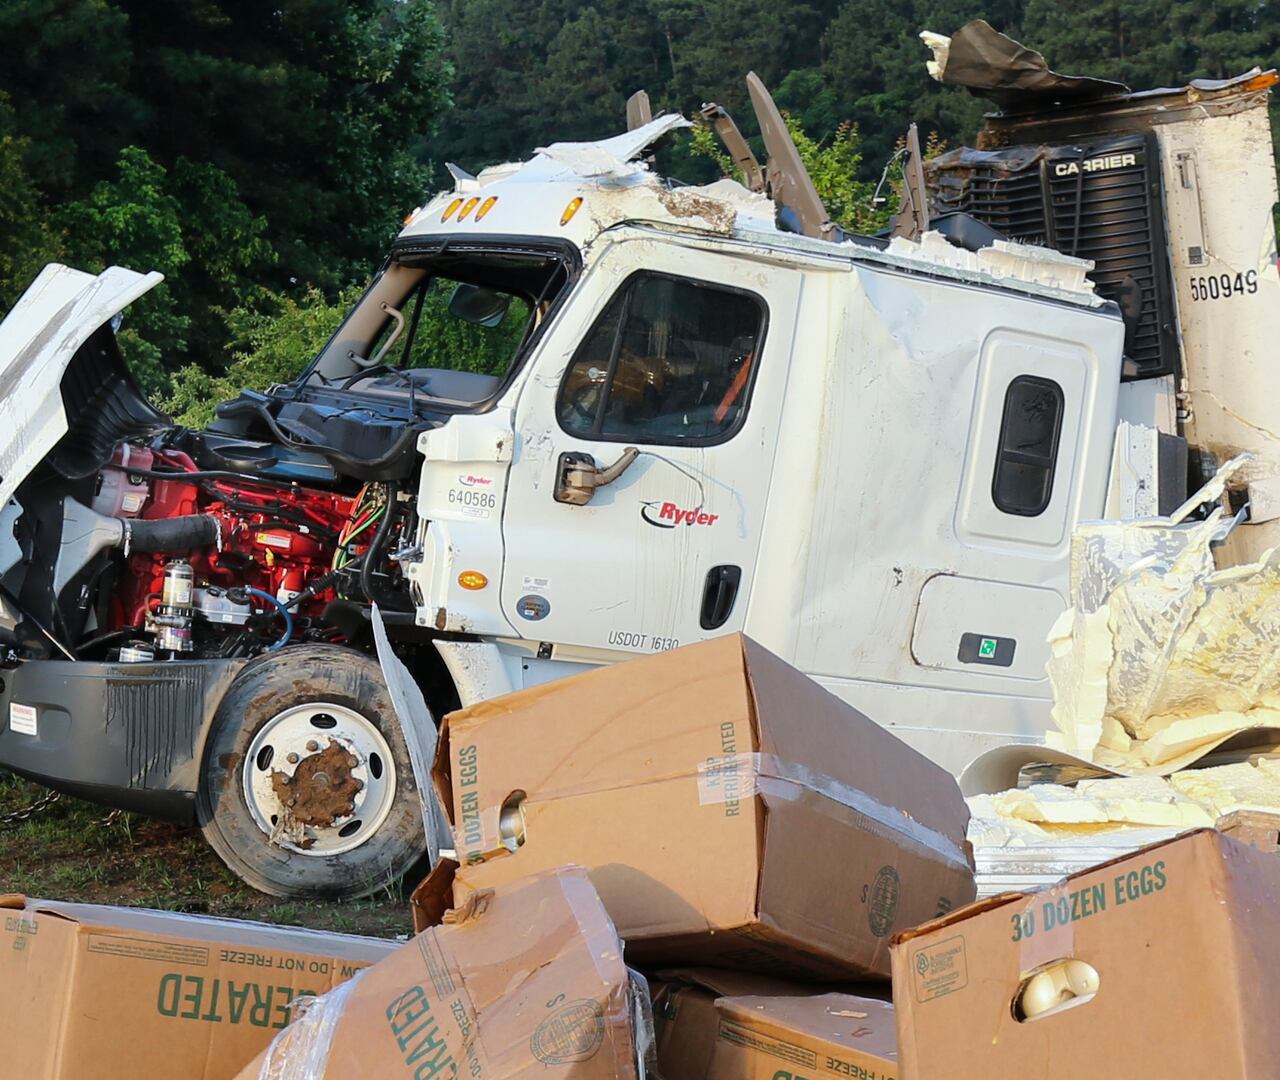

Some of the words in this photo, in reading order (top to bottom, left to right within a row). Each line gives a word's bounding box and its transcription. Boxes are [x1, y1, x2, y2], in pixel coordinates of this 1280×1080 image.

[1055, 154, 1136, 176] CARRIER
[1190, 270, 1258, 301] 560949
[467, 475, 493, 486] Ryder
[448, 489, 496, 508] 640586
[658, 502, 720, 527] Ryder
[608, 631, 646, 648] USDOT
[458, 744, 478, 787] EGGS
[721, 720, 740, 817] REFRIGERATED
[461, 790, 482, 846] DOZEN
[1010, 911, 1035, 942] 30
[1043, 883, 1106, 931] DOZEN
[1114, 860, 1168, 906] EGGS
[220, 949, 273, 968] FREEZE
[275, 954, 302, 972] NOT
